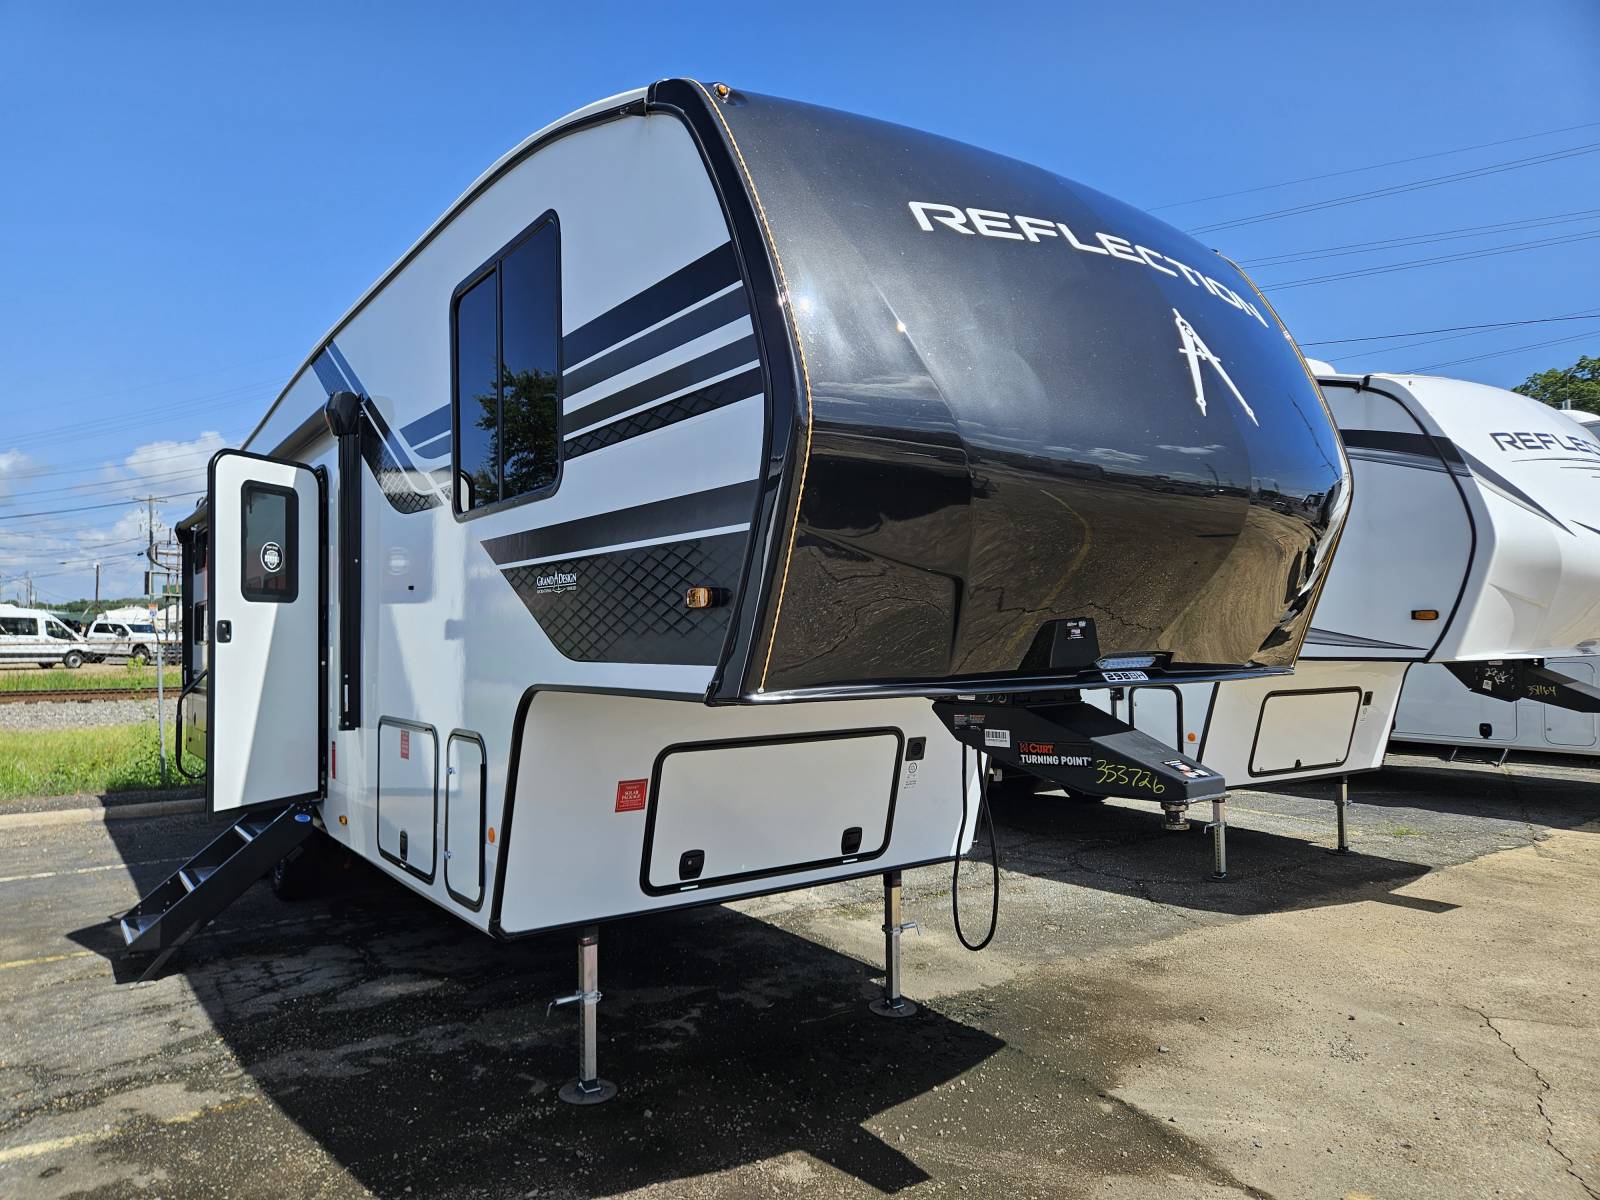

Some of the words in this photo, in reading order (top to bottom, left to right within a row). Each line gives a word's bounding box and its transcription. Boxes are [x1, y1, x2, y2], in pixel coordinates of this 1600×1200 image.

[908, 201, 1269, 328] REFLECTION
[536, 575, 554, 587] GRAND
[558, 572, 577, 584] DESIGN
[1029, 743, 1054, 754] CURT
[1020, 754, 1059, 765] TURNING
[1096, 759, 1165, 794] 353726
